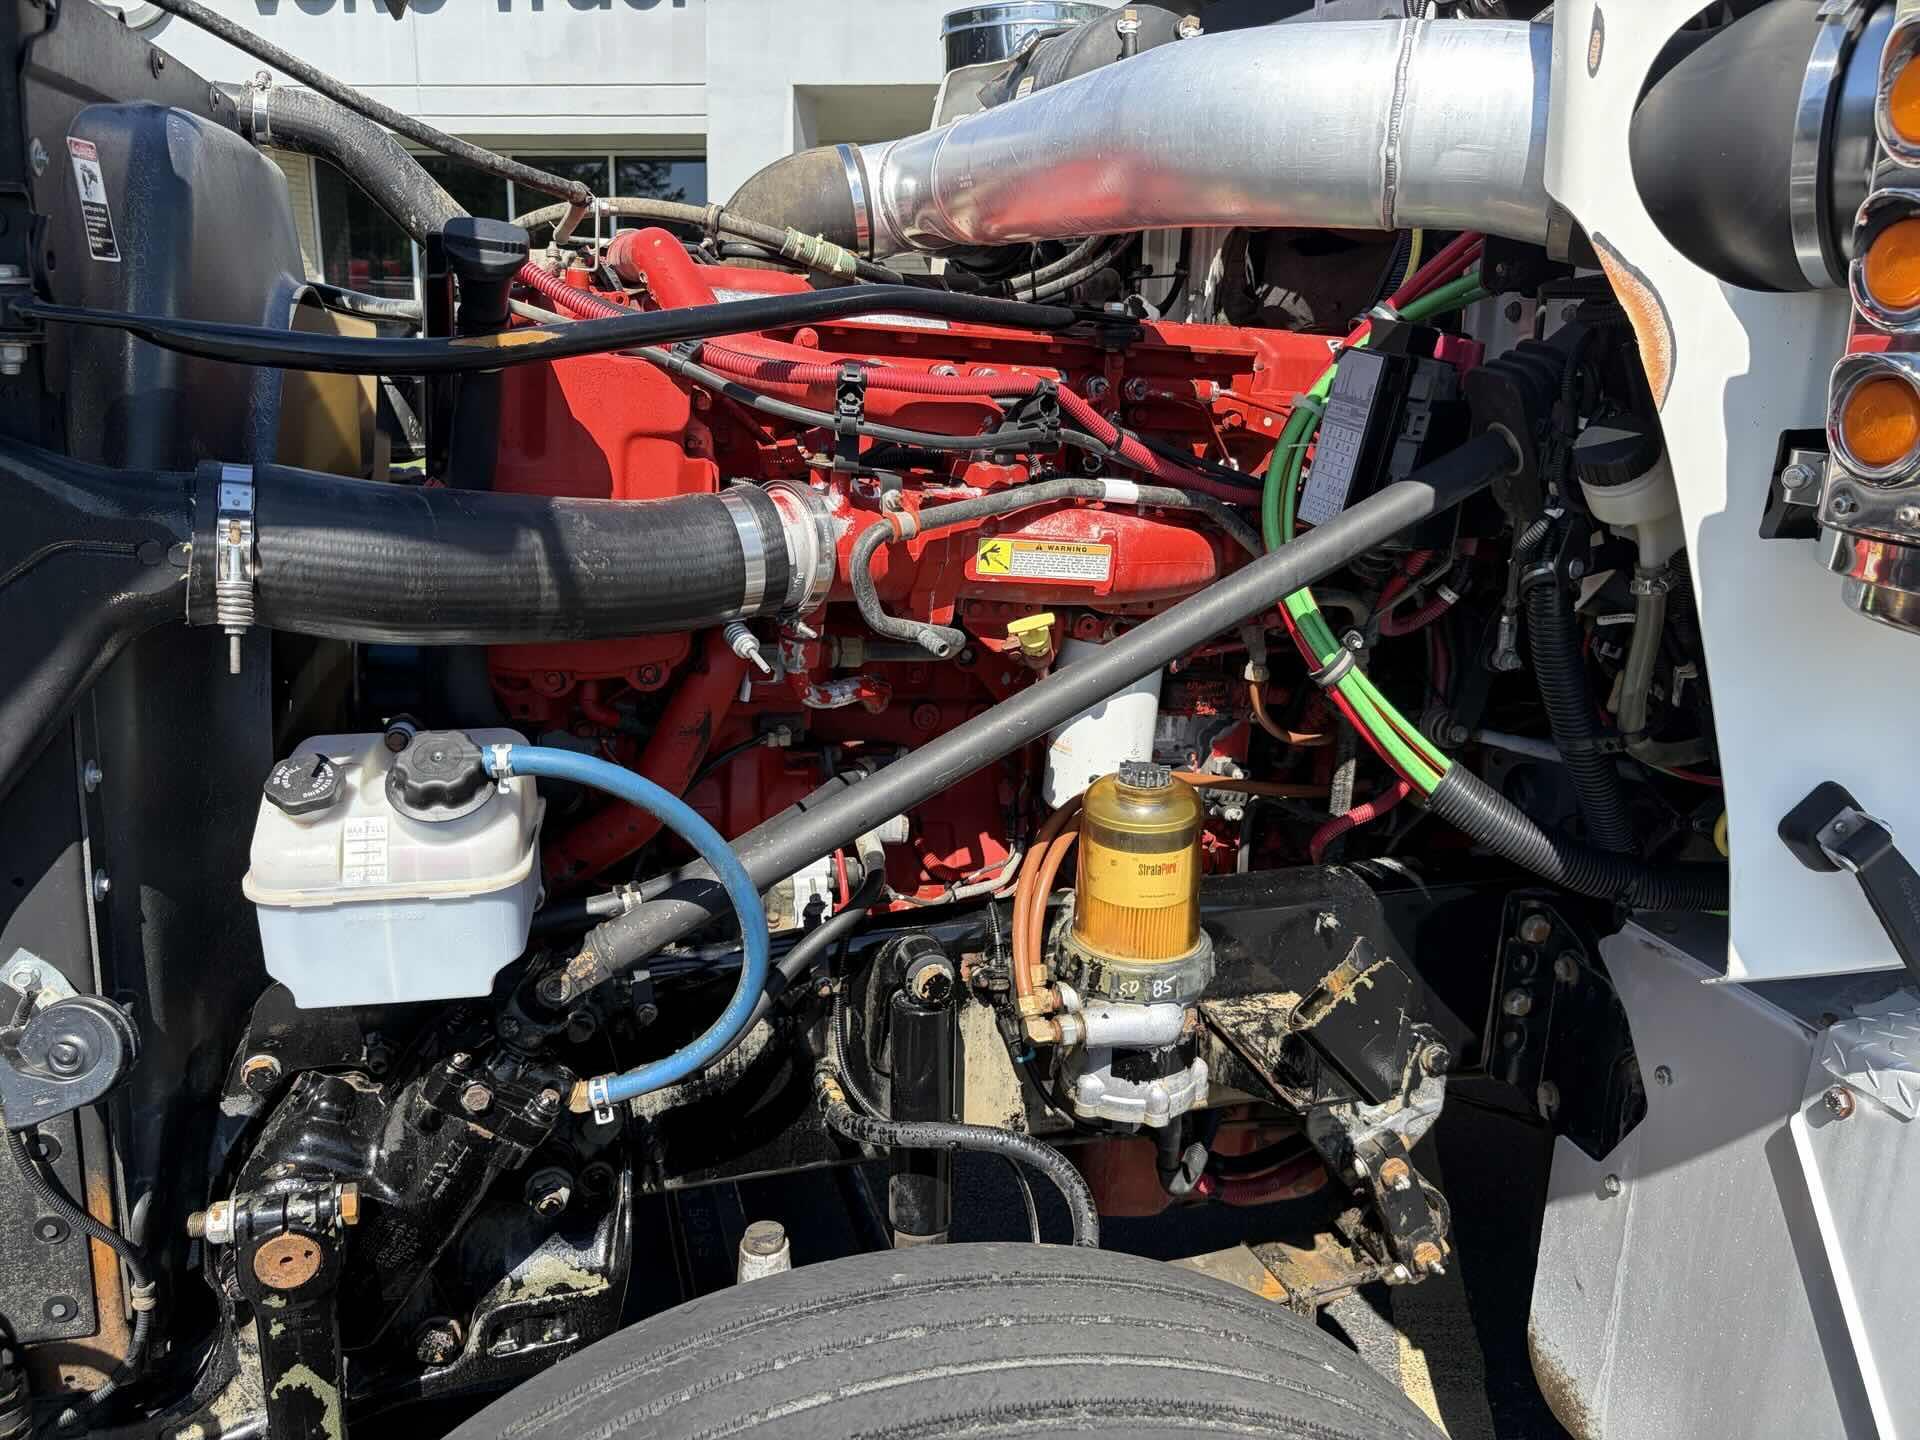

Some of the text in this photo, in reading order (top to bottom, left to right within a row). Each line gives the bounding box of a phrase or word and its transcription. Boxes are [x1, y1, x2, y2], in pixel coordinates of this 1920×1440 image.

[1047, 544, 1088, 553] WARNING
[273, 766, 288, 785] DO NOT
[281, 765, 302, 789] OVERFILL
[303, 779, 333, 798] STEERING
[1153, 975, 1177, 998] 85
